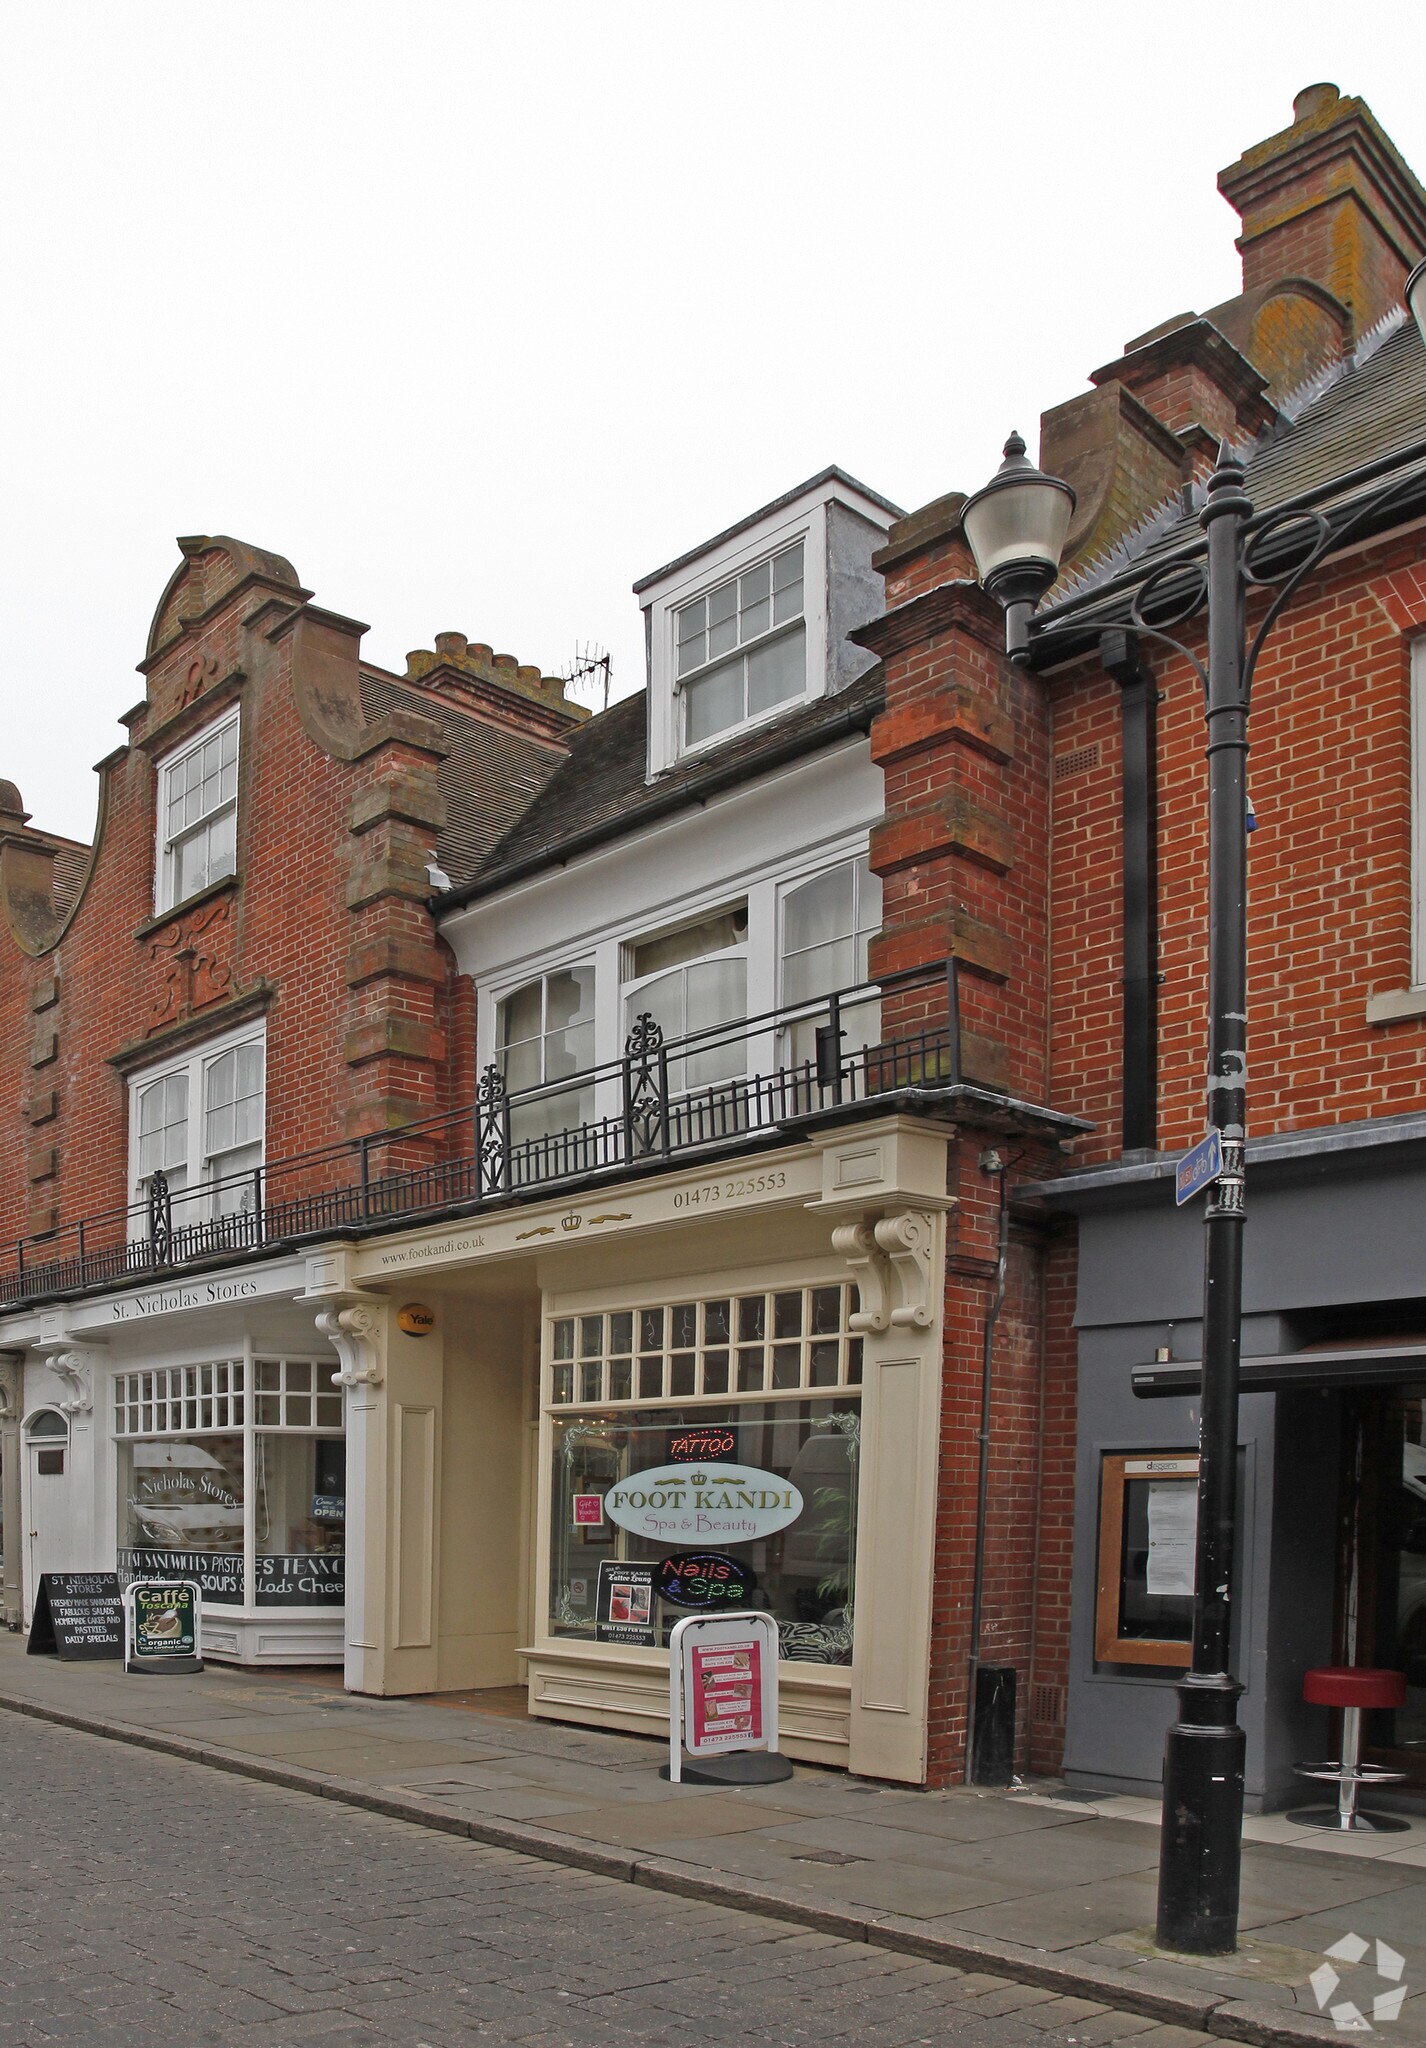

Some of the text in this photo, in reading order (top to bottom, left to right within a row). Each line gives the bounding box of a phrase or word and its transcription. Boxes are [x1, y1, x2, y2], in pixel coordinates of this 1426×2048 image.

[673, 1172, 786, 1208] 01473 225553
[381, 1235, 485, 1265] www.footkandi.co.uk
[113, 1280, 257, 1320] St. Nicholas Stores
[410, 1314, 434, 1326] Yale
[671, 1437, 735, 1453] TATTOO
[142, 1472, 195, 1494] Nicholas
[199, 1475, 239, 1509] Stores
[315, 1498, 334, 1506] Come
[579, 1500, 592, 1510] Gift
[613, 1490, 793, 1509] FOOT KANDI
[314, 1509, 344, 1517] OPEN
[642, 1513, 757, 1536] Spa & Beauty
[145, 1553, 208, 1571] SANDWICHES
[663, 1560, 731, 1579] Nails
[52, 1575, 115, 1585] ST NICHOLAS
[118, 1568, 166, 1583] Handmade
[201, 1574, 237, 1592] SOUPS
[630, 1574, 652, 1584] Loung
[66, 1584, 102, 1594] STORES
[667, 1577, 744, 1599] & Spa
[50, 1599, 73, 1607] FRESHLY
[90, 1598, 121, 1606] SANDWICHES
[138, 1589, 189, 1605] Caffé
[60, 1607, 115, 1616] FABULOUS SALADS
[54, 1616, 121, 1626] HOMEMADE CAKES AND
[75, 1626, 107, 1634] PASTRIES
[65, 1634, 118, 1644] DAILY SPECIALS
[724, 1733, 747, 1741] 225553
